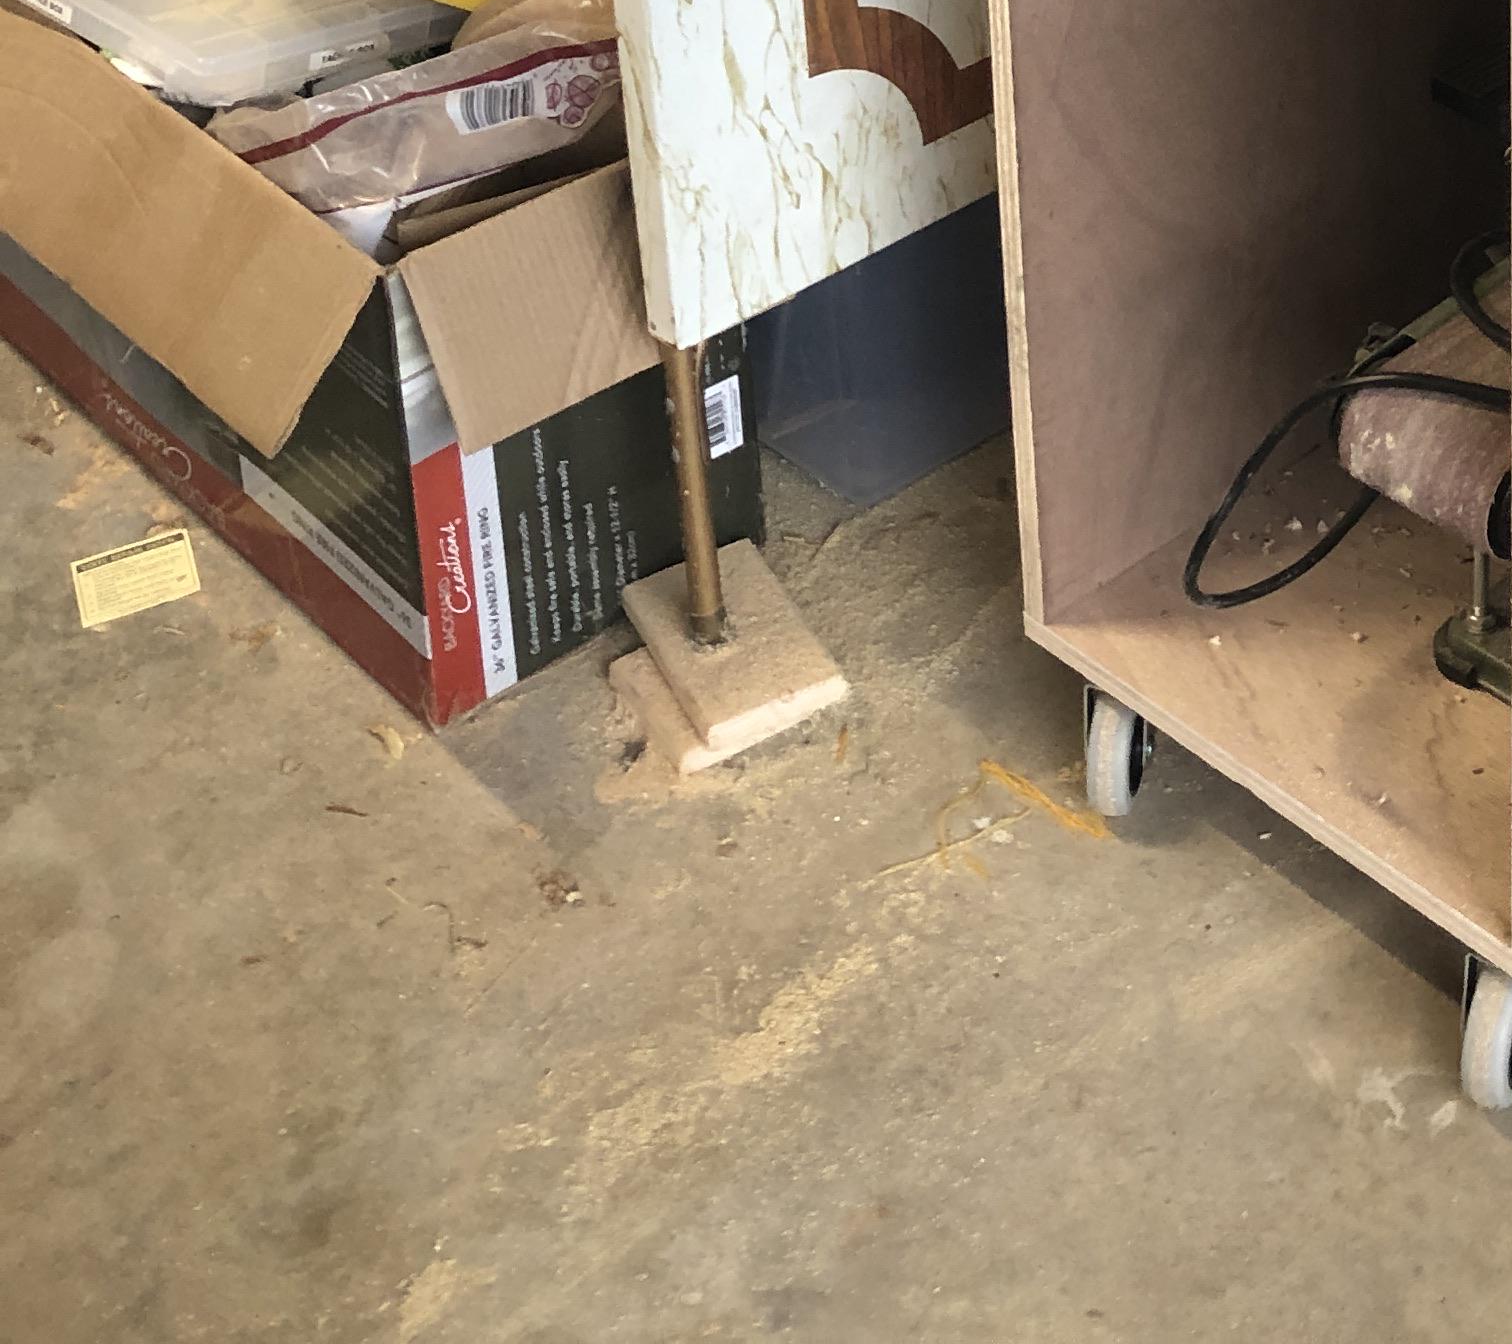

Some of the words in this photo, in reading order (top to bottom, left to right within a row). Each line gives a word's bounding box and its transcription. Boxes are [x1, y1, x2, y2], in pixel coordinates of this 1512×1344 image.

[477, 507, 491, 540] RING
[436, 521, 472, 614] Creations
[481, 540, 494, 570] FIRE
[483, 571, 503, 651] GALVANIZED
